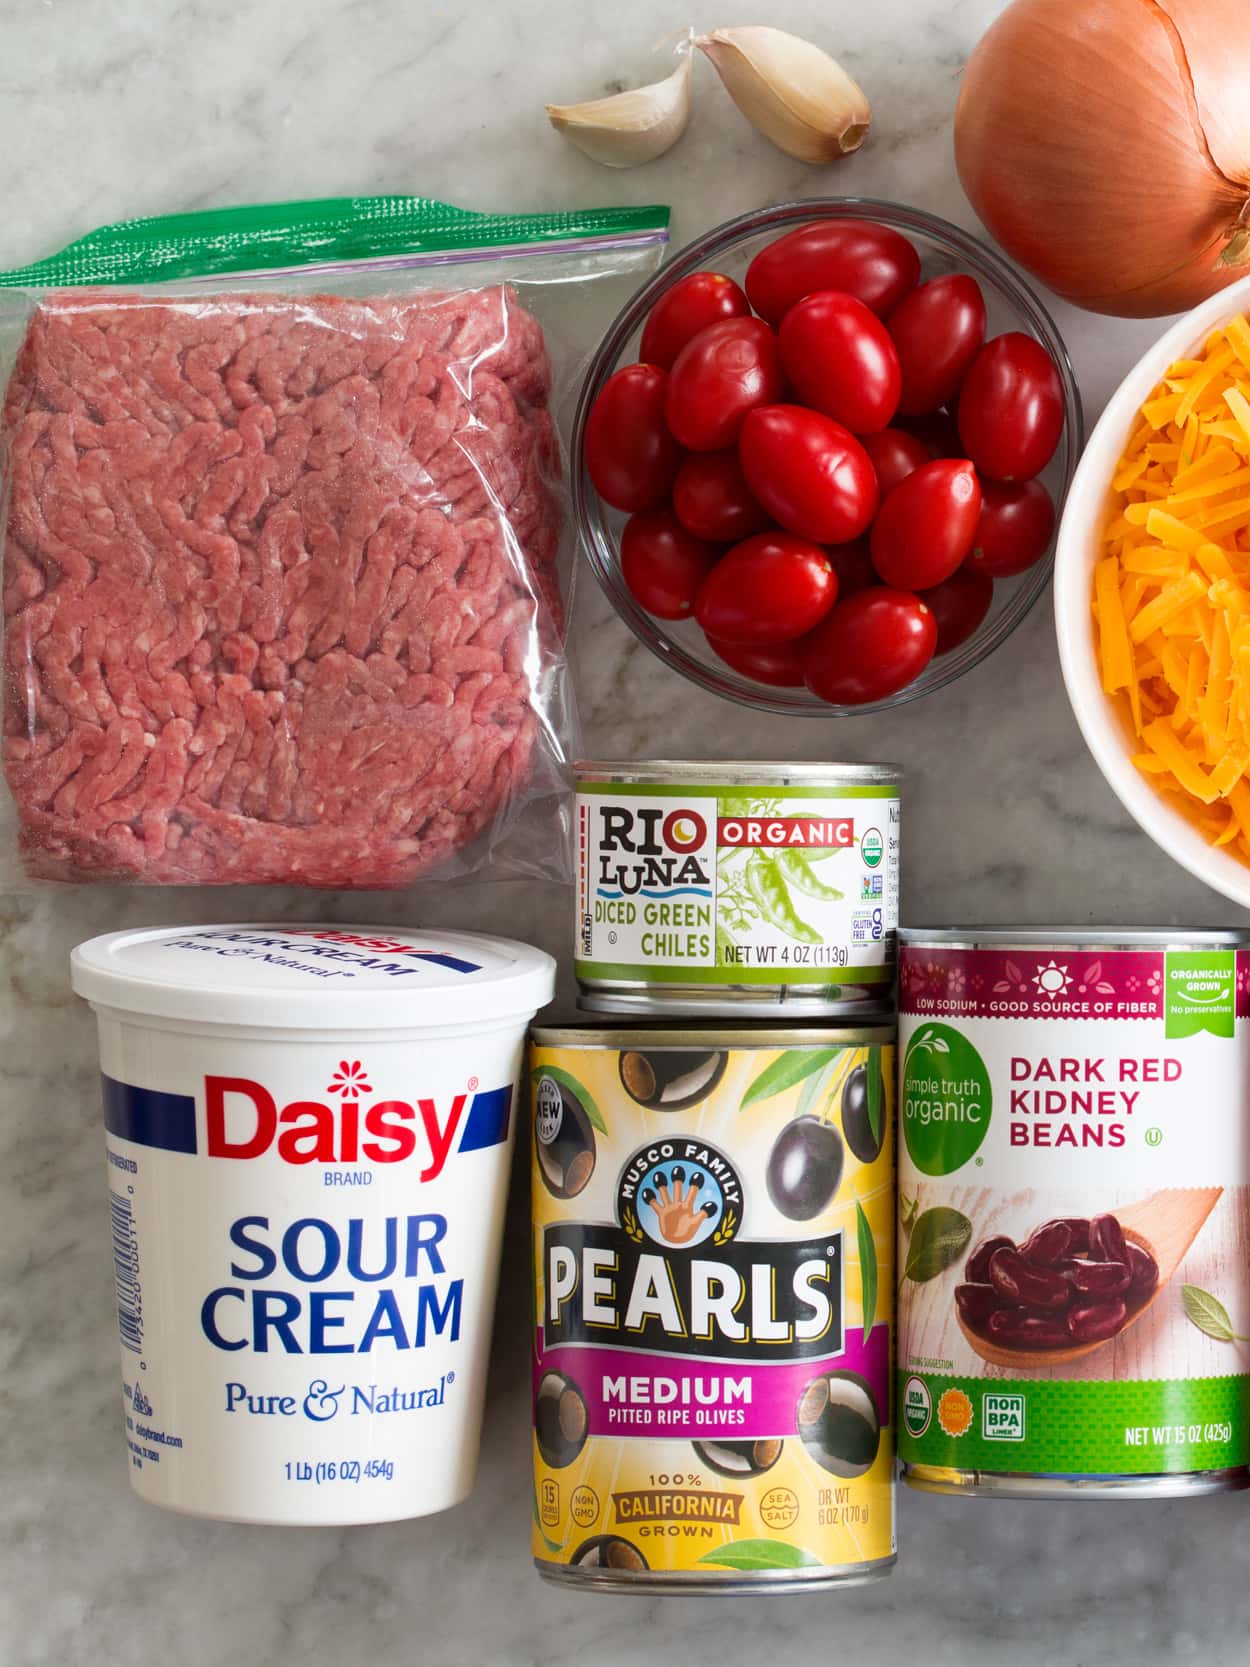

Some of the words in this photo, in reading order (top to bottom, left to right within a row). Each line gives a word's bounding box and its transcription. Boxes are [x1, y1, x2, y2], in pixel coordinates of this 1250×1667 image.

[599, 806, 707, 855] RIO
[722, 822, 849, 844] ORGANIC
[599, 855, 710, 895] LUNA
[595, 900, 637, 925] DICED
[644, 902, 711, 927] GREEN
[853, 919, 873, 930] GLUTEN
[641, 932, 710, 958] CHILES
[853, 930, 865, 940] FREE
[251, 953, 342, 978] Natural
[281, 943, 420, 976] CREAM
[725, 946, 752, 963] NET
[756, 946, 776, 963] WT
[780, 946, 789, 963] 4
[793, 945, 810, 963] OZ
[814, 945, 849, 967] (113g)
[1170, 969, 1232, 979] ORGANICALLY
[1186, 982, 1221, 991] GROWN
[917, 998, 934, 1010] LOW
[937, 998, 977, 1011] SODIUM
[990, 1001, 1029, 1013] GOOD
[1033, 1001, 1089, 1013] SOURCE
[1094, 1001, 1114, 1014] OF
[1117, 1001, 1157, 1014] FIBER
[1170, 1005, 1183, 1014] No
[1185, 1005, 1232, 1015] preservatives
[1010, 1058, 1105, 1082] DARK
[1119, 1058, 1183, 1082] RED
[906, 1076, 939, 1095] simple
[941, 1078, 981, 1096] truth
[905, 1097, 981, 1125] organic
[1010, 1090, 1140, 1115] KIDNEY
[204, 1062, 467, 1183] Daisy
[1010, 1122, 1126, 1148] BEANS
[324, 1171, 373, 1187] BRAND
[622, 1144, 674, 1199] MUSCO
[685, 1144, 740, 1204] FAMILY
[229, 1213, 448, 1283] SOUR
[550, 1246, 832, 1342] PEARLS
[200, 1278, 464, 1354] CREAM
[225, 1382, 296, 1417] Pure
[302, 1379, 346, 1421] &
[351, 1376, 446, 1415] Natural
[602, 1375, 752, 1405] MEDIUM
[909, 1391, 923, 1405] USDA
[989, 1398, 1020, 1411] non
[608, 1408, 651, 1425] PITTED
[657, 1409, 690, 1425] RIPE
[696, 1409, 745, 1425] OLIVES
[988, 1413, 1019, 1427] BPA
[1125, 1427, 1149, 1446] NET
[1152, 1426, 1172, 1446] WT
[1175, 1425, 1185, 1444] 15
[1188, 1425, 1201, 1443] OZ
[1204, 1421, 1232, 1443] (425g)
[285, 1462, 291, 1480] 1
[296, 1462, 312, 1480] Lb
[316, 1461, 336, 1484] (16
[364, 1459, 393, 1480] 454g
[649, 1473, 702, 1487] 100%
[544, 1485, 555, 1504] 15
[575, 1495, 594, 1505] NON
[769, 1494, 791, 1503] SEA
[818, 1489, 832, 1506] DR
[834, 1487, 850, 1504] WT
[575, 1507, 594, 1518] GMO
[619, 1495, 736, 1519] CALIFORNIA
[767, 1511, 793, 1521] SALT
[818, 1509, 825, 1525] 6
[827, 1507, 839, 1525] OZ
[639, 1526, 713, 1538] GROWN
